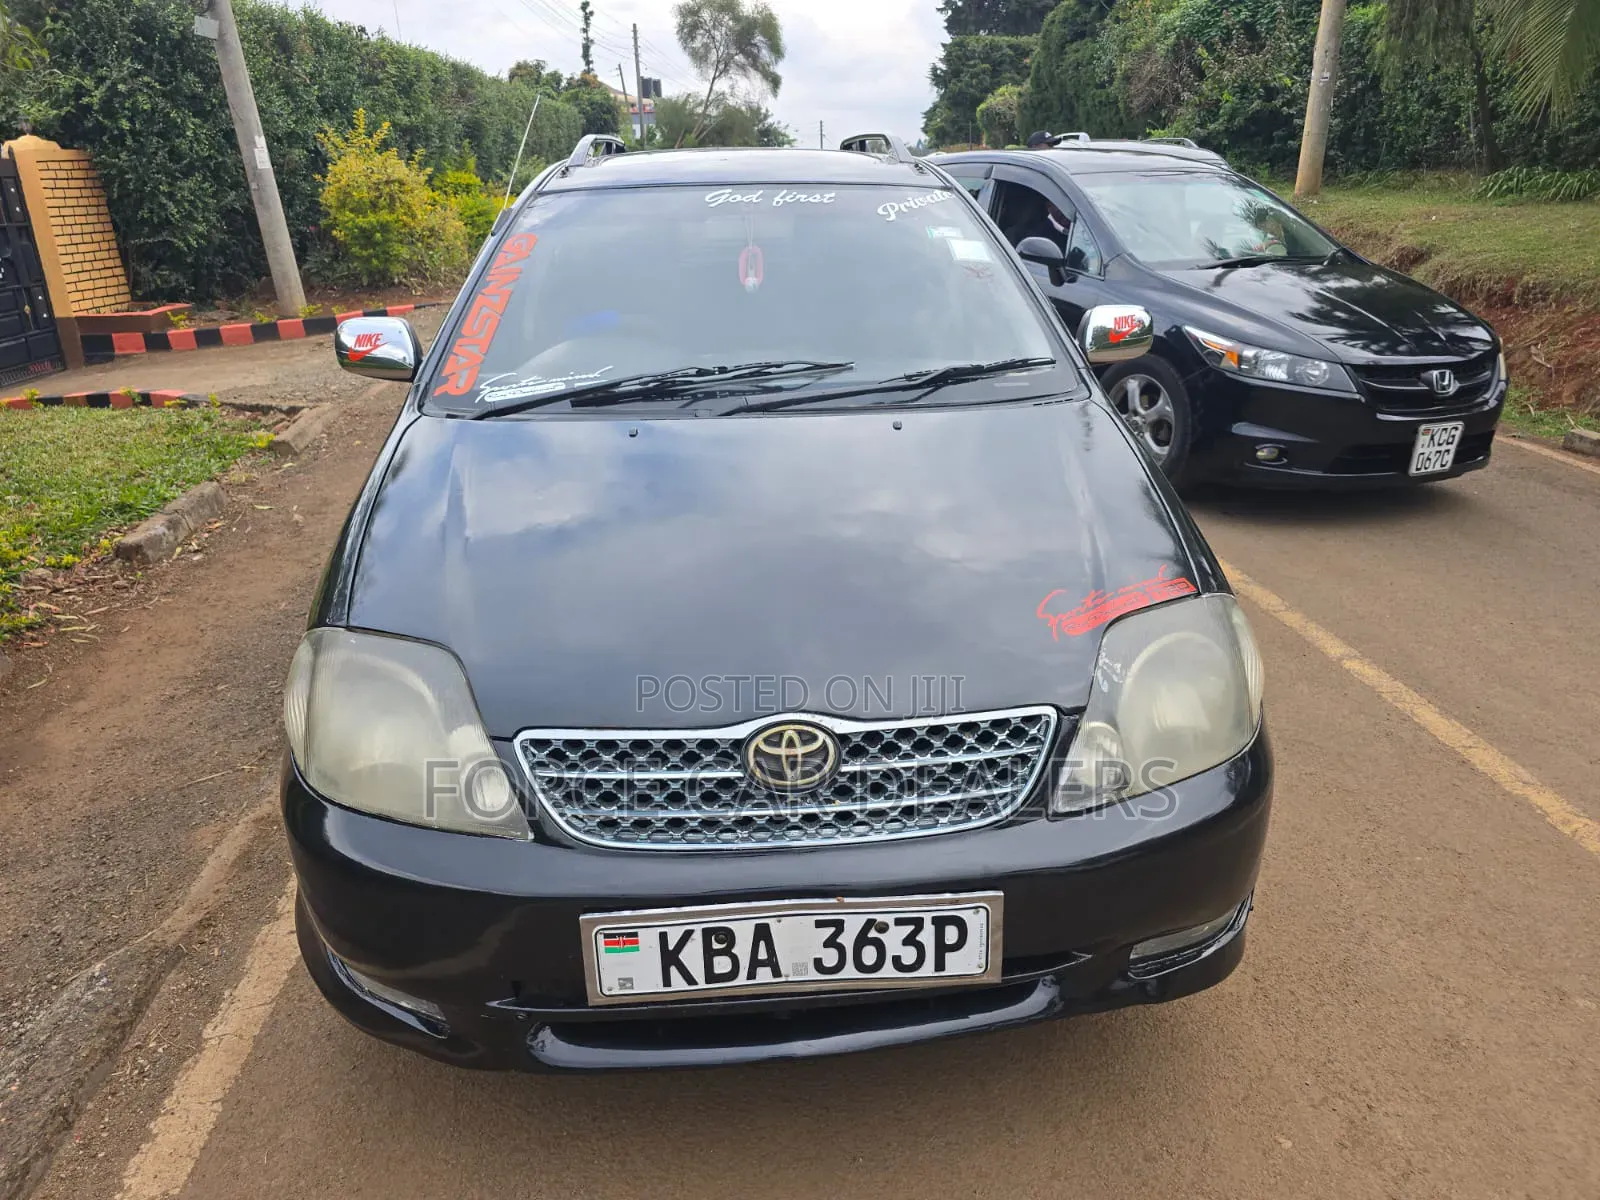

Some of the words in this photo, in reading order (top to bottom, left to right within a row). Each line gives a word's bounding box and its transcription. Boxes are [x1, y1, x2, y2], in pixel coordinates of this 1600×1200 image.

[705, 189, 762, 207] God
[772, 190, 836, 207] first
[1113, 315, 1136, 331] NIKE
[354, 333, 383, 348] NIKE
[1427, 426, 1459, 448] KCG
[1415, 449, 1451, 471] 067C
[658, 922, 783, 988] KBA
[813, 915, 969, 976] 363P
